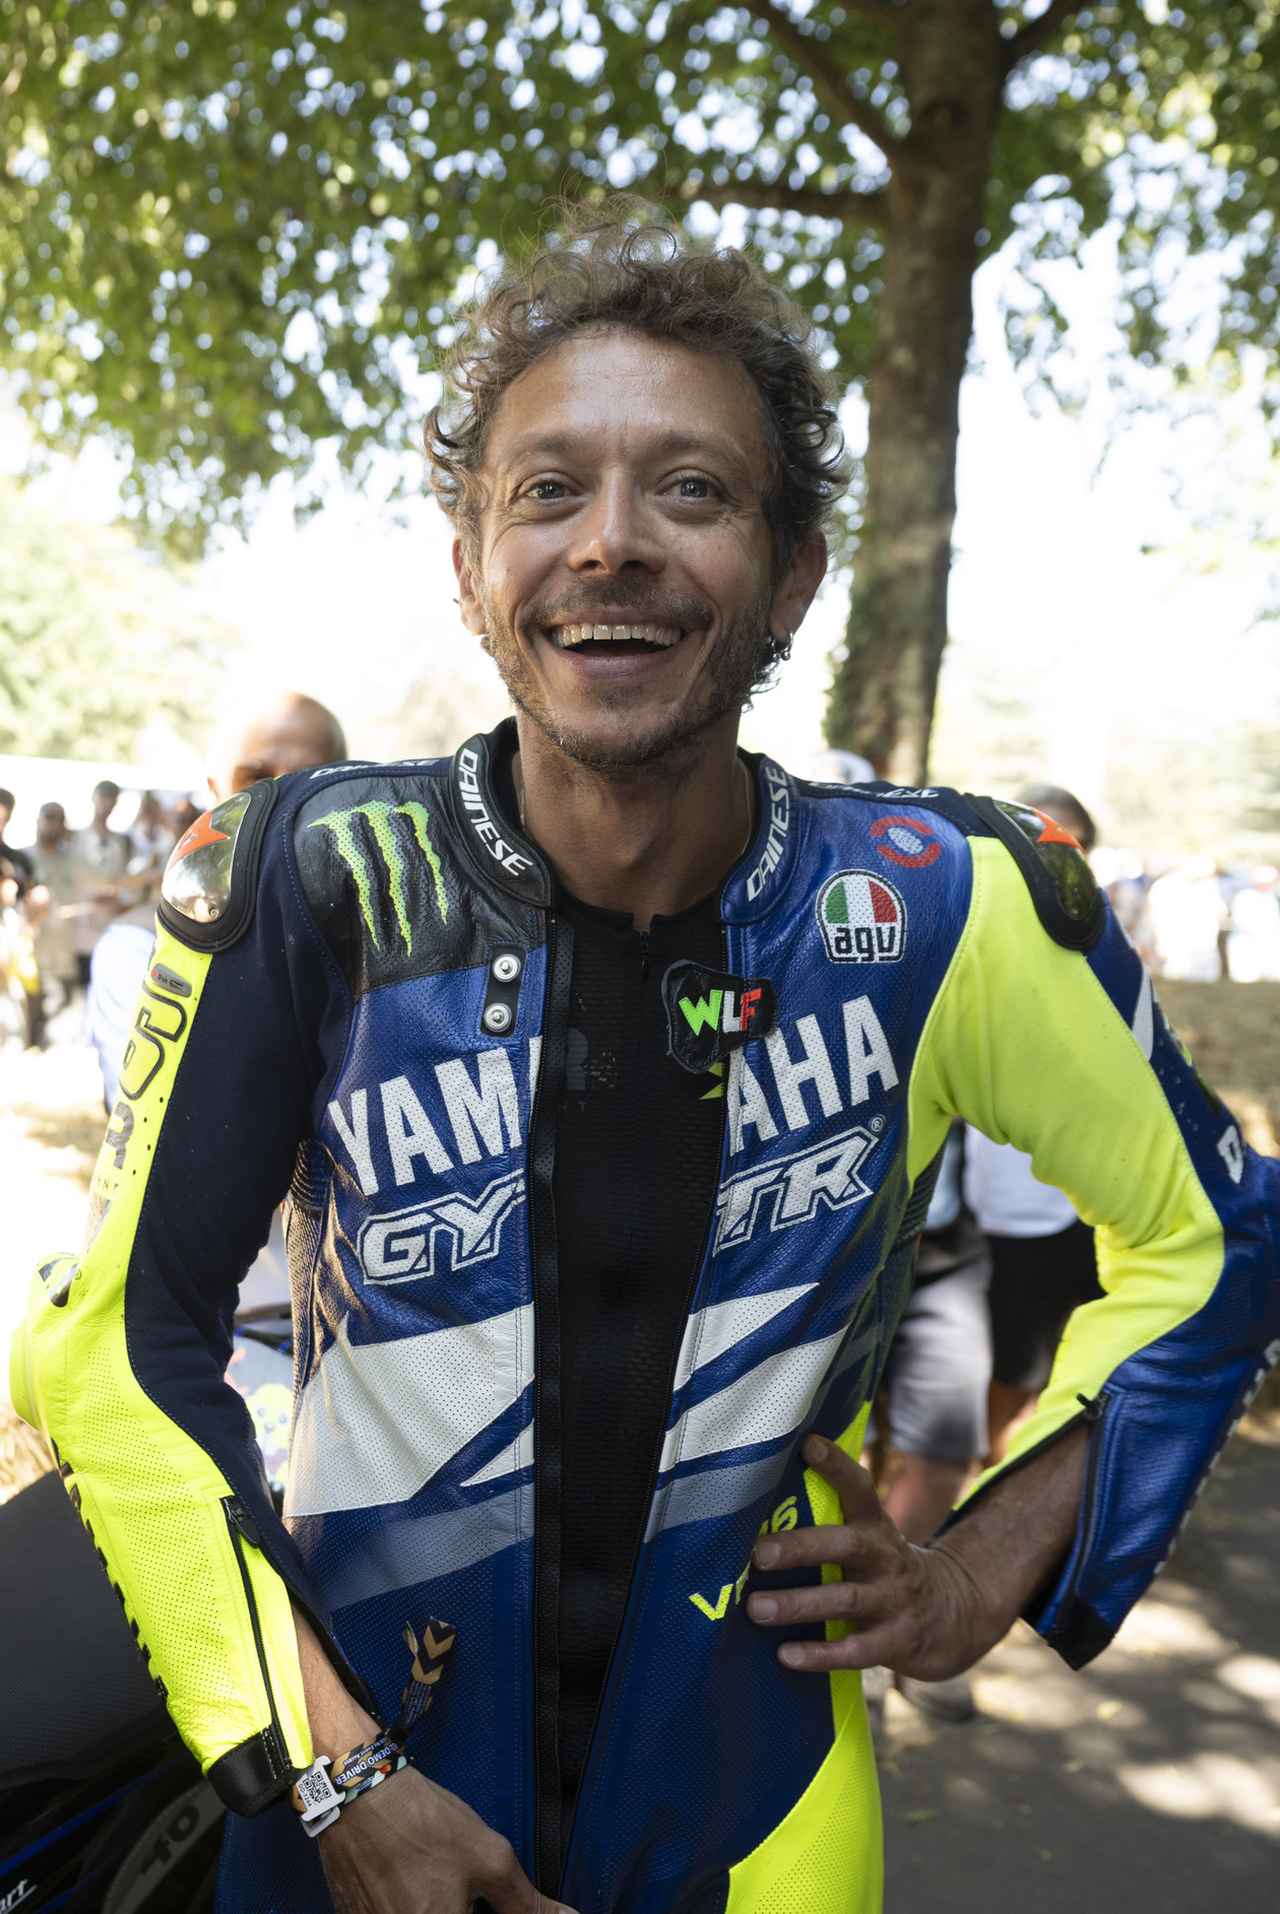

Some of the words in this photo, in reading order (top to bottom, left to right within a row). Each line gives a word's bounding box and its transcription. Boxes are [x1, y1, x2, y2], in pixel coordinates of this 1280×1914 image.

[459, 748, 534, 876] DAINESE
[747, 767, 790, 901] DAINESE
[834, 926, 896, 962] agv
[678, 988, 763, 1037] WLF
[328, 1036, 542, 1196] YAM
[335, 1763, 367, 1785] DRIVER
